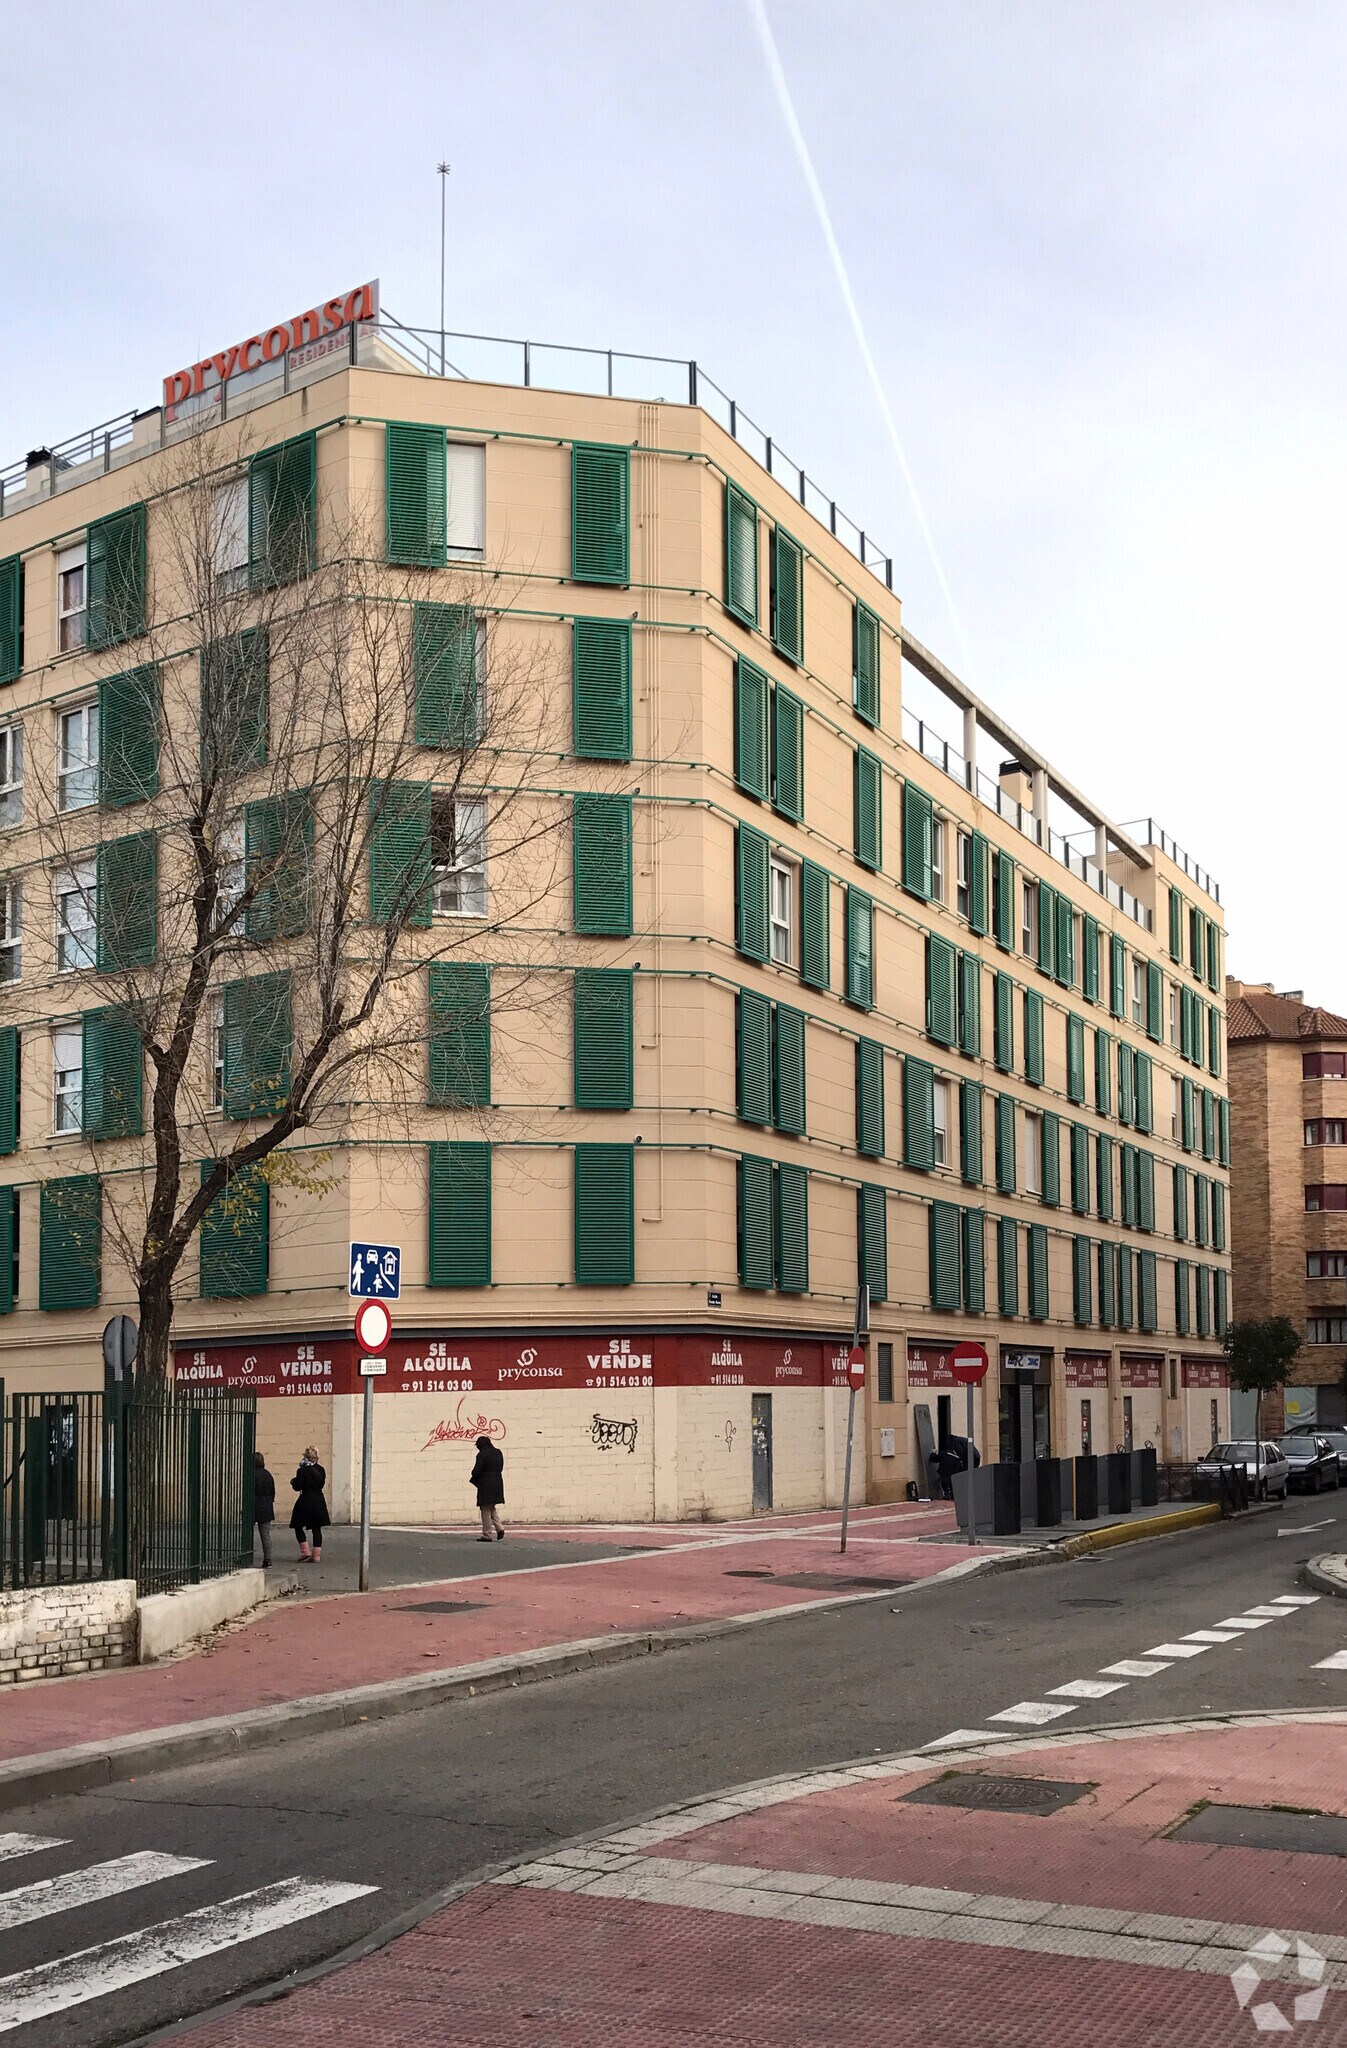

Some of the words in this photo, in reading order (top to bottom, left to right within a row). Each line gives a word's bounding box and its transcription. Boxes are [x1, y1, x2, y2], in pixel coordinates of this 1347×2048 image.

[163, 284, 375, 424] pryconsa
[428, 1342, 447, 1357] SE
[608, 1339, 631, 1354] SE
[722, 1339, 732, 1352] SE
[839, 1345, 848, 1358] SE
[193, 1352, 206, 1366] SE
[297, 1345, 315, 1361] SE
[711, 1352, 743, 1366] ALQUILA
[280, 1360, 332, 1377] VENDE
[403, 1356, 472, 1372] ALQUILA
[586, 1354, 652, 1370] VENDE
[176, 1365, 224, 1381] ALQUILA
[497, 1367, 563, 1381] pryconsa
[775, 1365, 803, 1378] pryconsa
[227, 1374, 276, 1389] pryconsa
[286, 1383, 295, 1395] 91
[297, 1382, 311, 1394] 514
[312, 1382, 322, 1394] 03
[323, 1381, 333, 1393] 00
[412, 1380, 423, 1392] 91
[427, 1380, 445, 1392] 514
[447, 1379, 459, 1391] 03
[461, 1379, 473, 1391] 00
[595, 1375, 606, 1387] 91
[609, 1375, 626, 1387] 514
[628, 1375, 640, 1387] 03
[642, 1375, 653, 1386] 00
